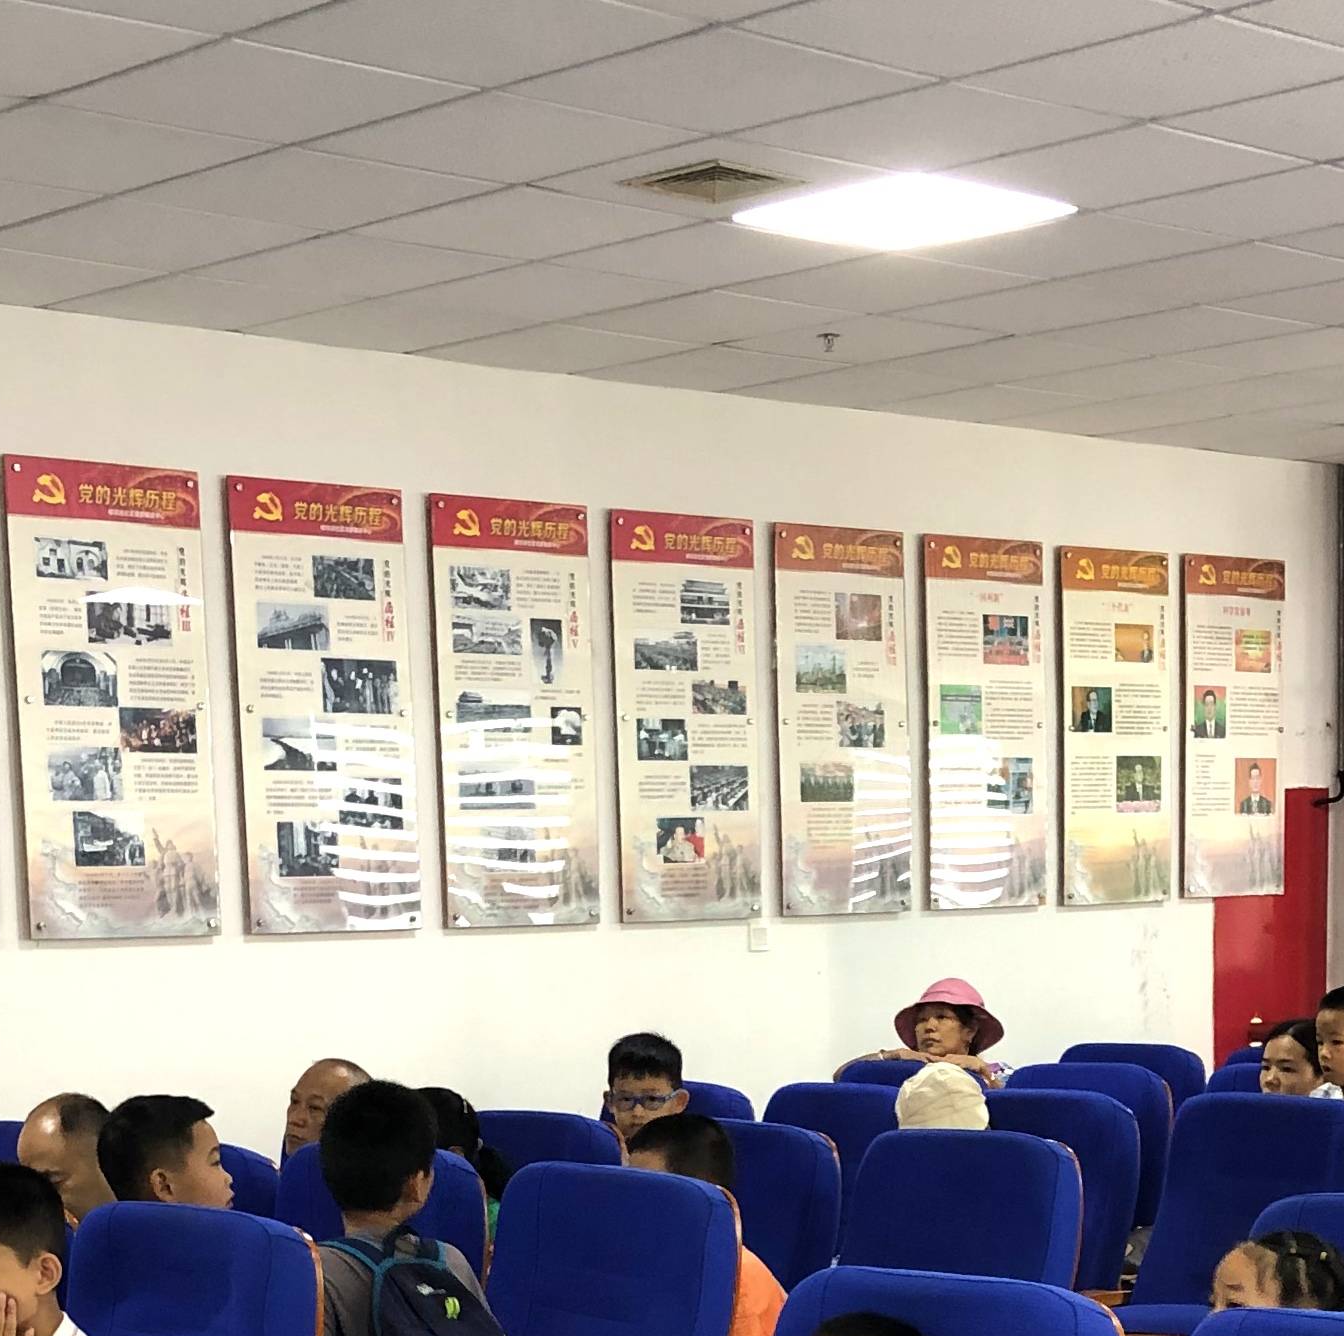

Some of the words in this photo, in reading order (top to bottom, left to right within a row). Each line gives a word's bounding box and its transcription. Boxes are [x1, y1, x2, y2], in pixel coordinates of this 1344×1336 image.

[78, 483, 177, 512] 党的光辉历程
[293, 501, 384, 528] 党的光辉历程
[489, 517, 570, 541] 党的光辉历程
